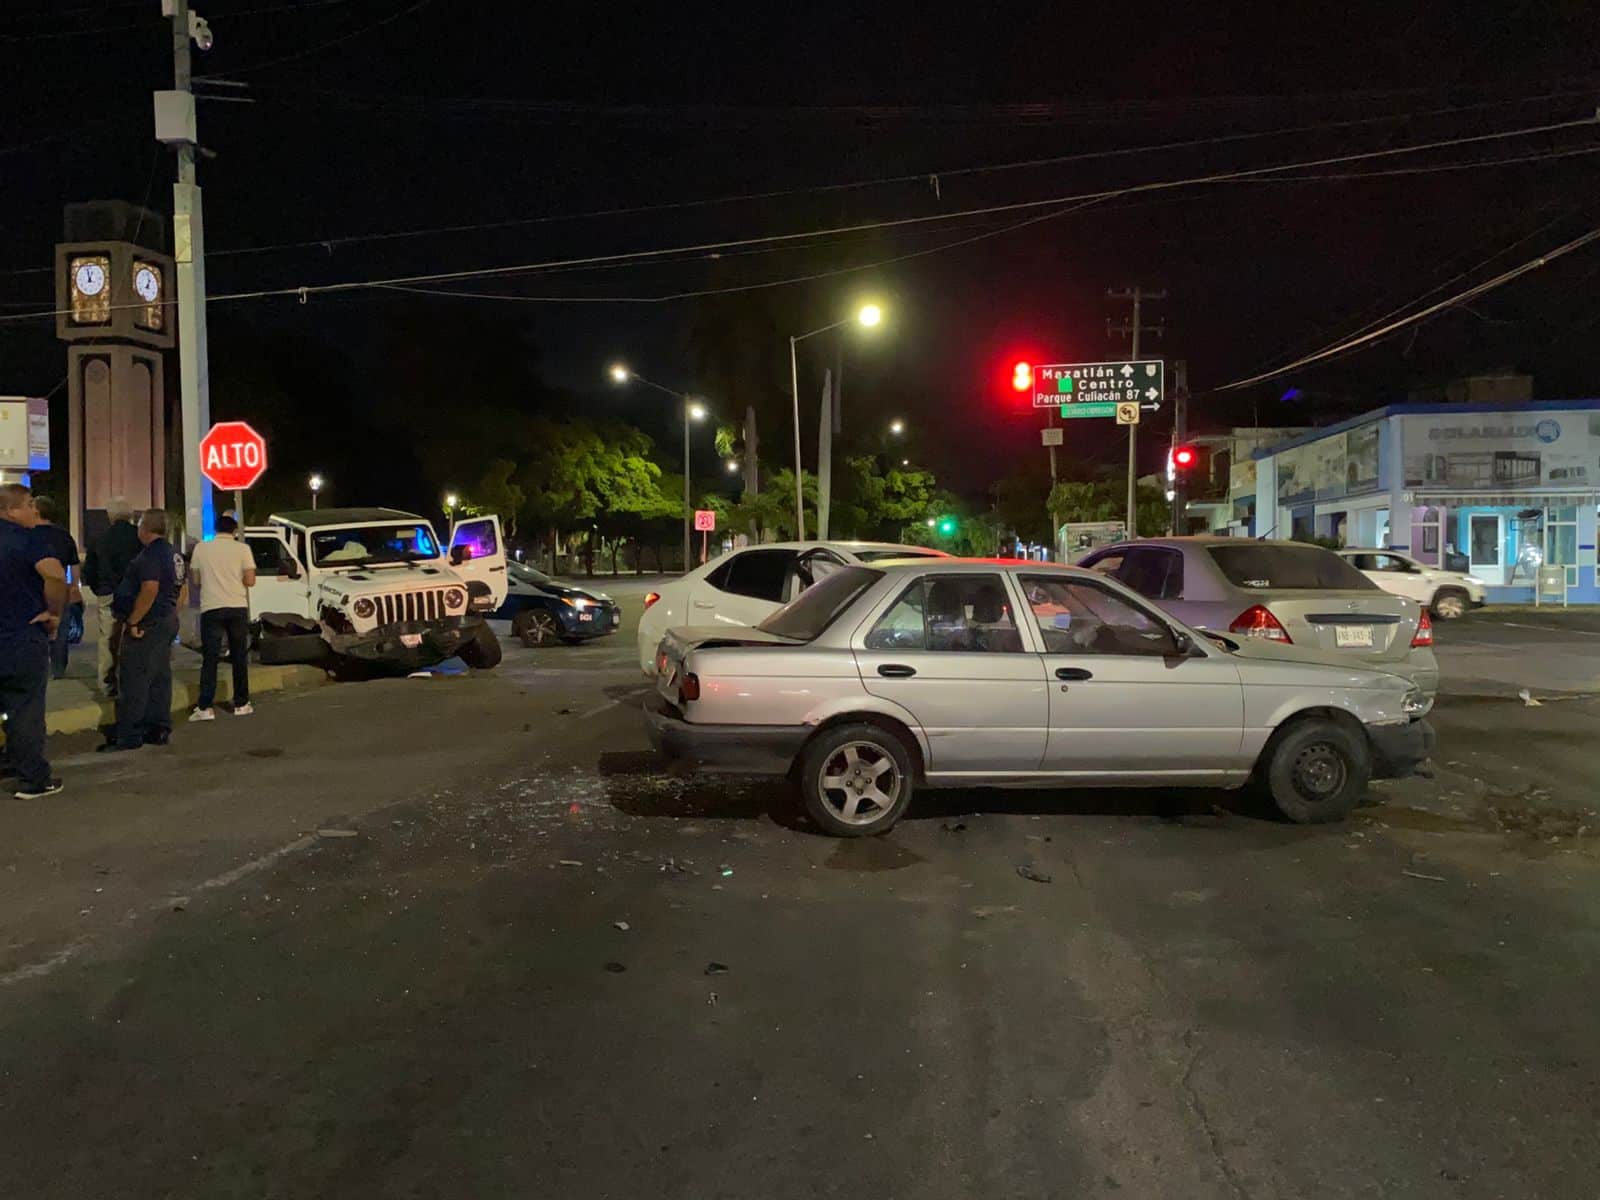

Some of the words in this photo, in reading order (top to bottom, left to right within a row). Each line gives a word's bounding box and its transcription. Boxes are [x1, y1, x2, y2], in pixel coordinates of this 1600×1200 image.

[1042, 366, 1114, 379] Mazatlán
[1078, 379, 1134, 390] Centro
[1037, 392, 1072, 404] Parque
[1078, 391, 1121, 402] Culiacán
[1126, 389, 1140, 400] 87
[207, 442, 259, 470] ALTO
